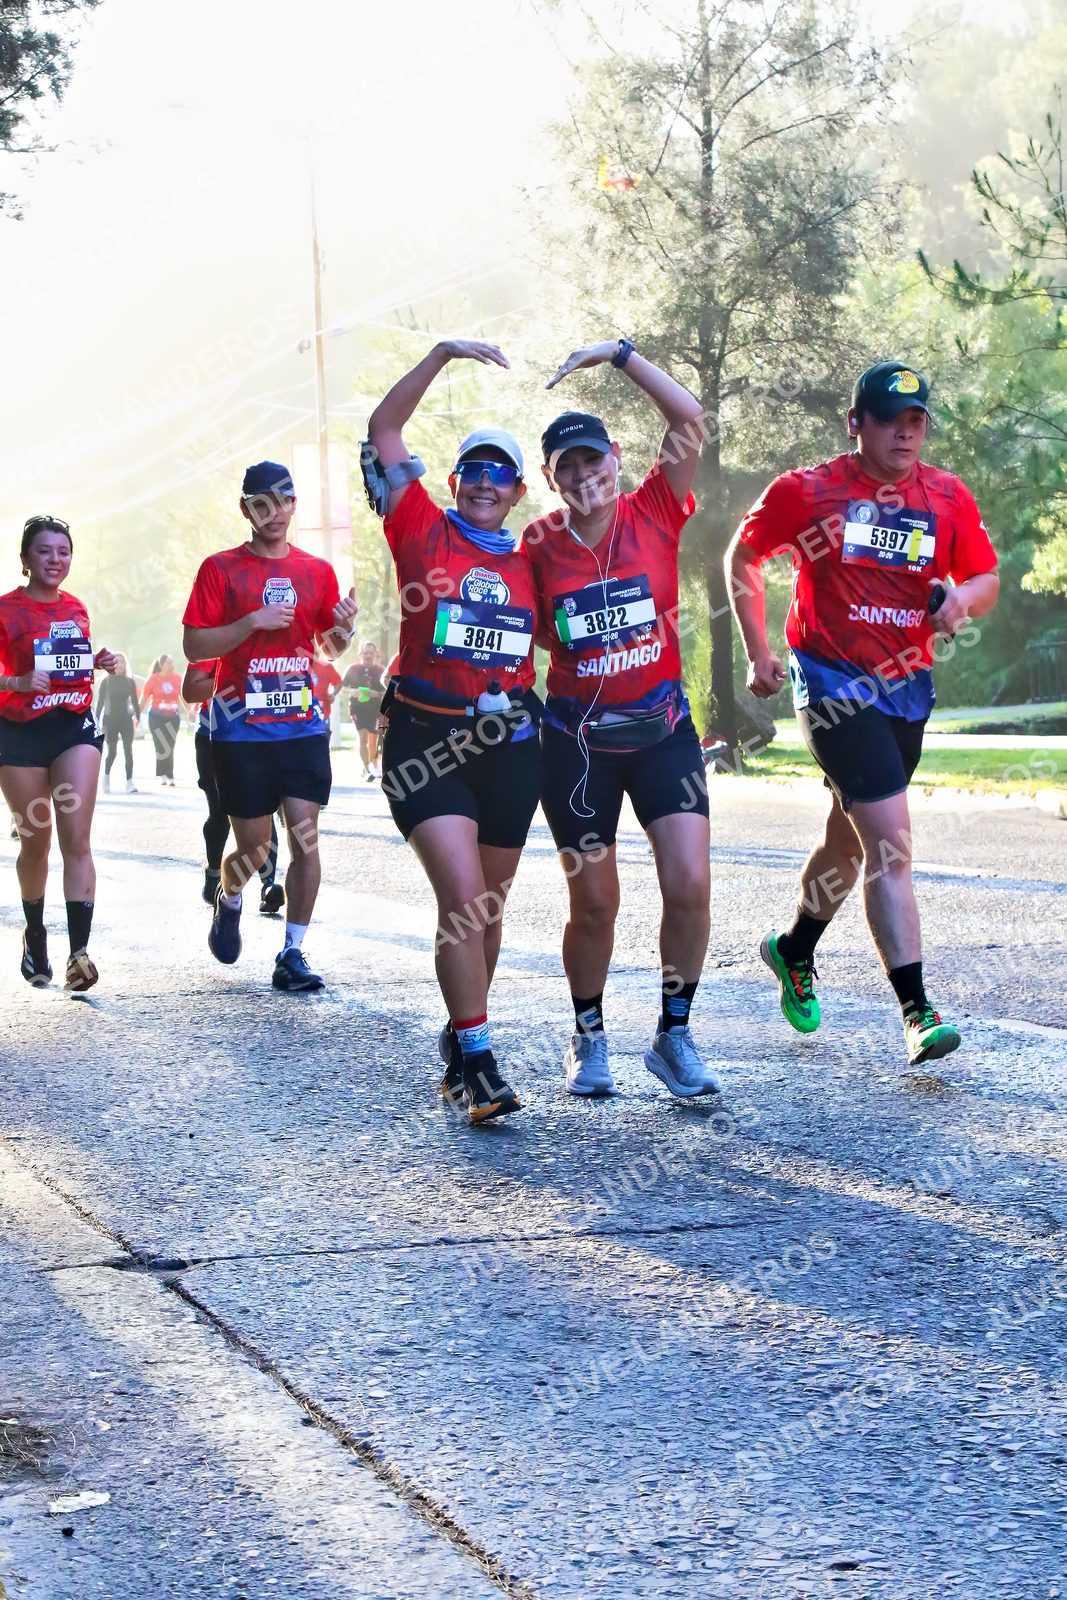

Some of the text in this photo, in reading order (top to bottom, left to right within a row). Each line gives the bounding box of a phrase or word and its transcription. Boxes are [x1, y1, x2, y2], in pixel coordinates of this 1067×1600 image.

[559, 423, 584, 436] KIPRUN
[870, 527, 908, 551] 5397
[473, 579, 498, 590] Global
[584, 606, 630, 635] 3822
[848, 603, 926, 628] SANTIAGO
[463, 626, 503, 652] 3841
[55, 655, 81, 669] 5467
[247, 656, 310, 674] SANTIAGO
[576, 641, 661, 678] SANTIAGO
[266, 692, 293, 707] 5641
